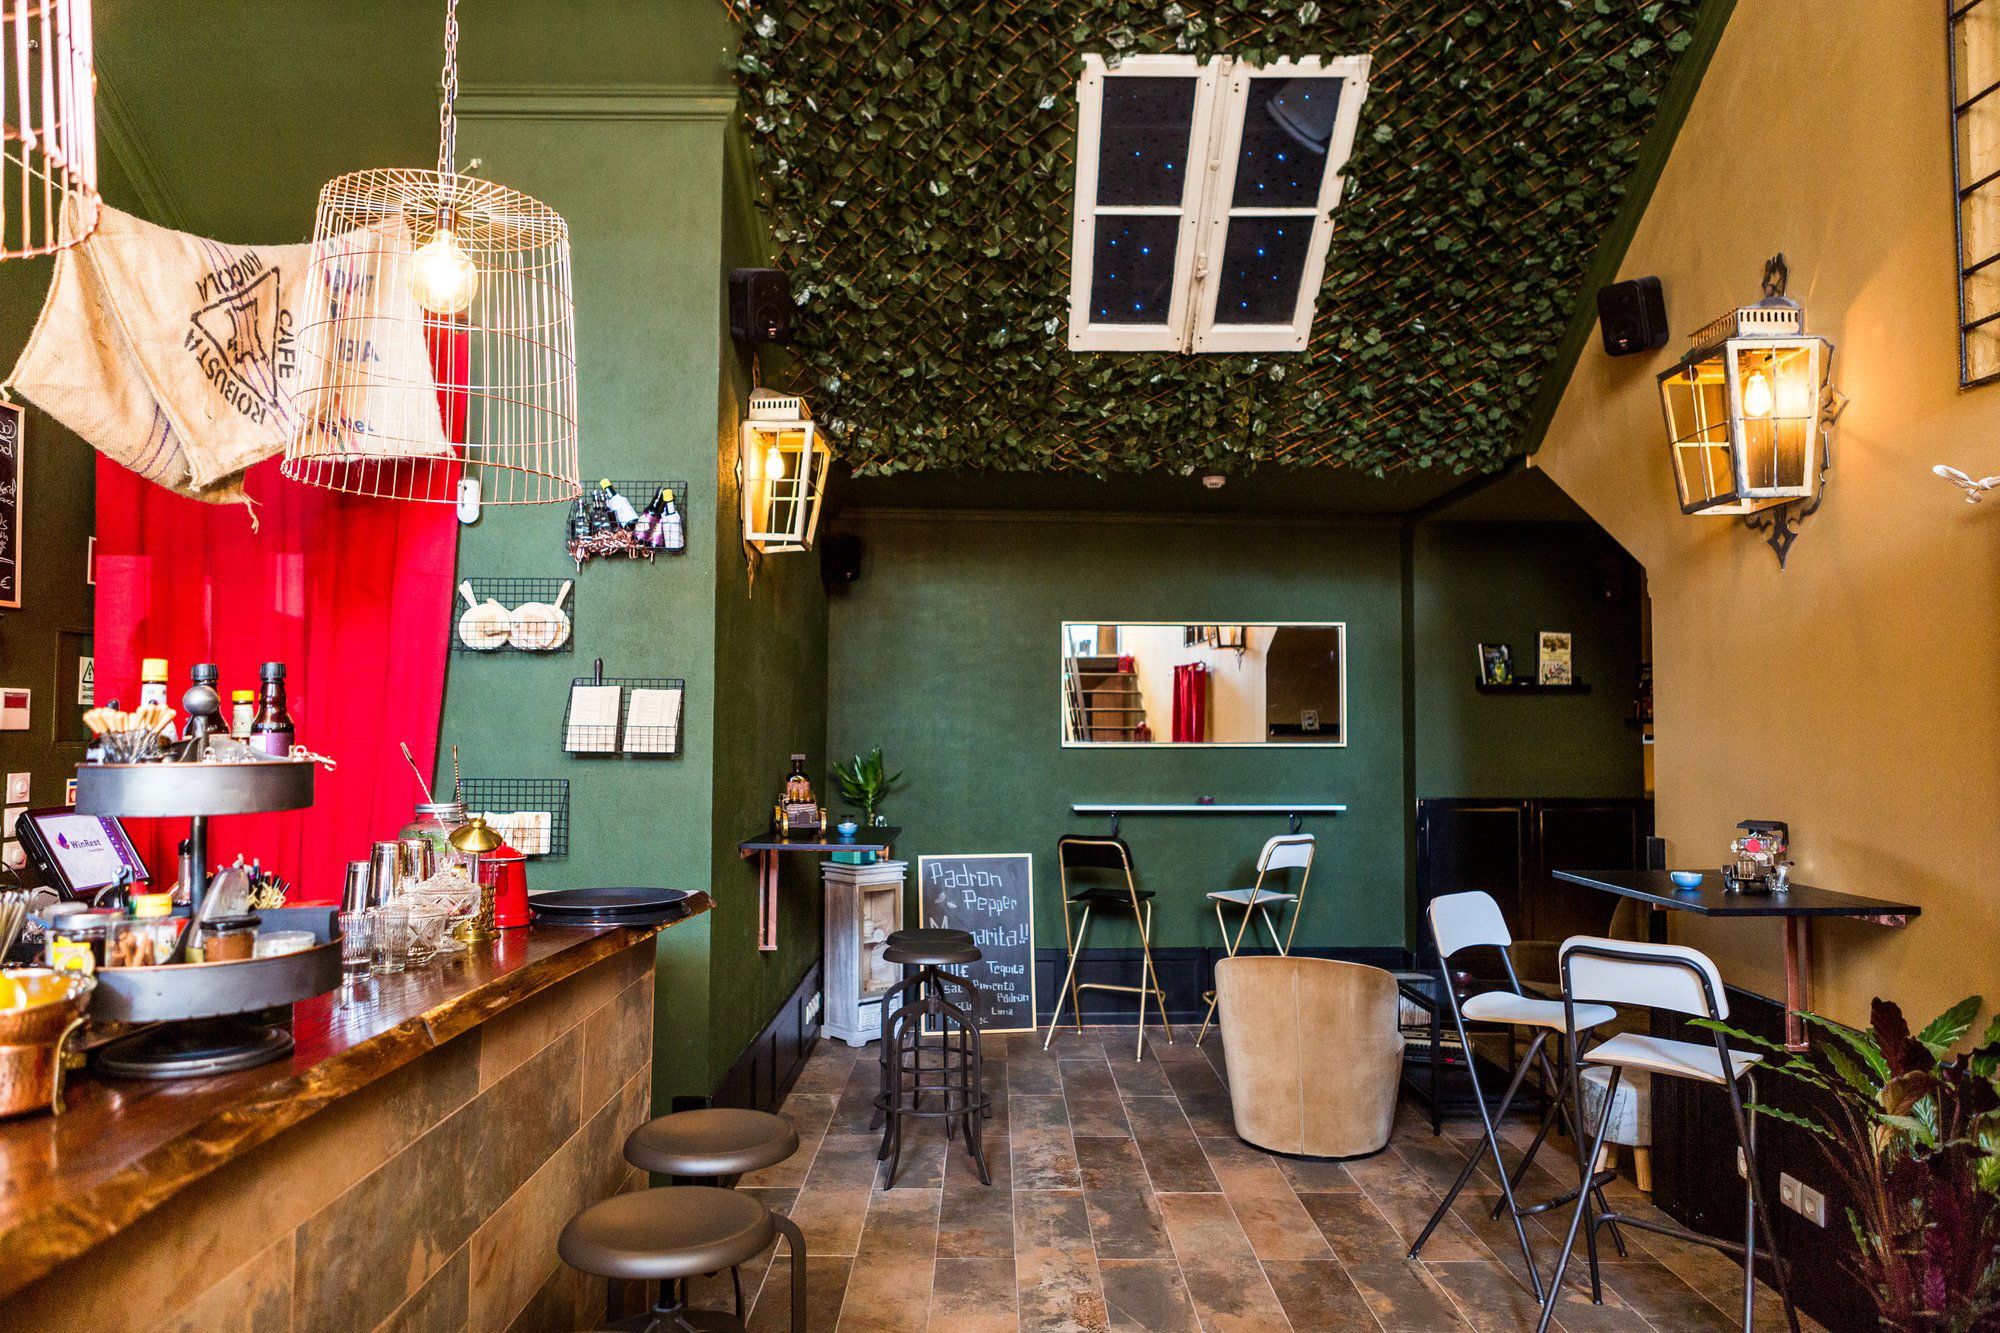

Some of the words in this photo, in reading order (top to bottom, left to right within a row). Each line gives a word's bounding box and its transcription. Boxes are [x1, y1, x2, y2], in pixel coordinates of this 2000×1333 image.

[183, 328, 267, 426] ROBUSTA
[70, 838, 101, 850] WinRest
[928, 862, 1003, 888] Padron
